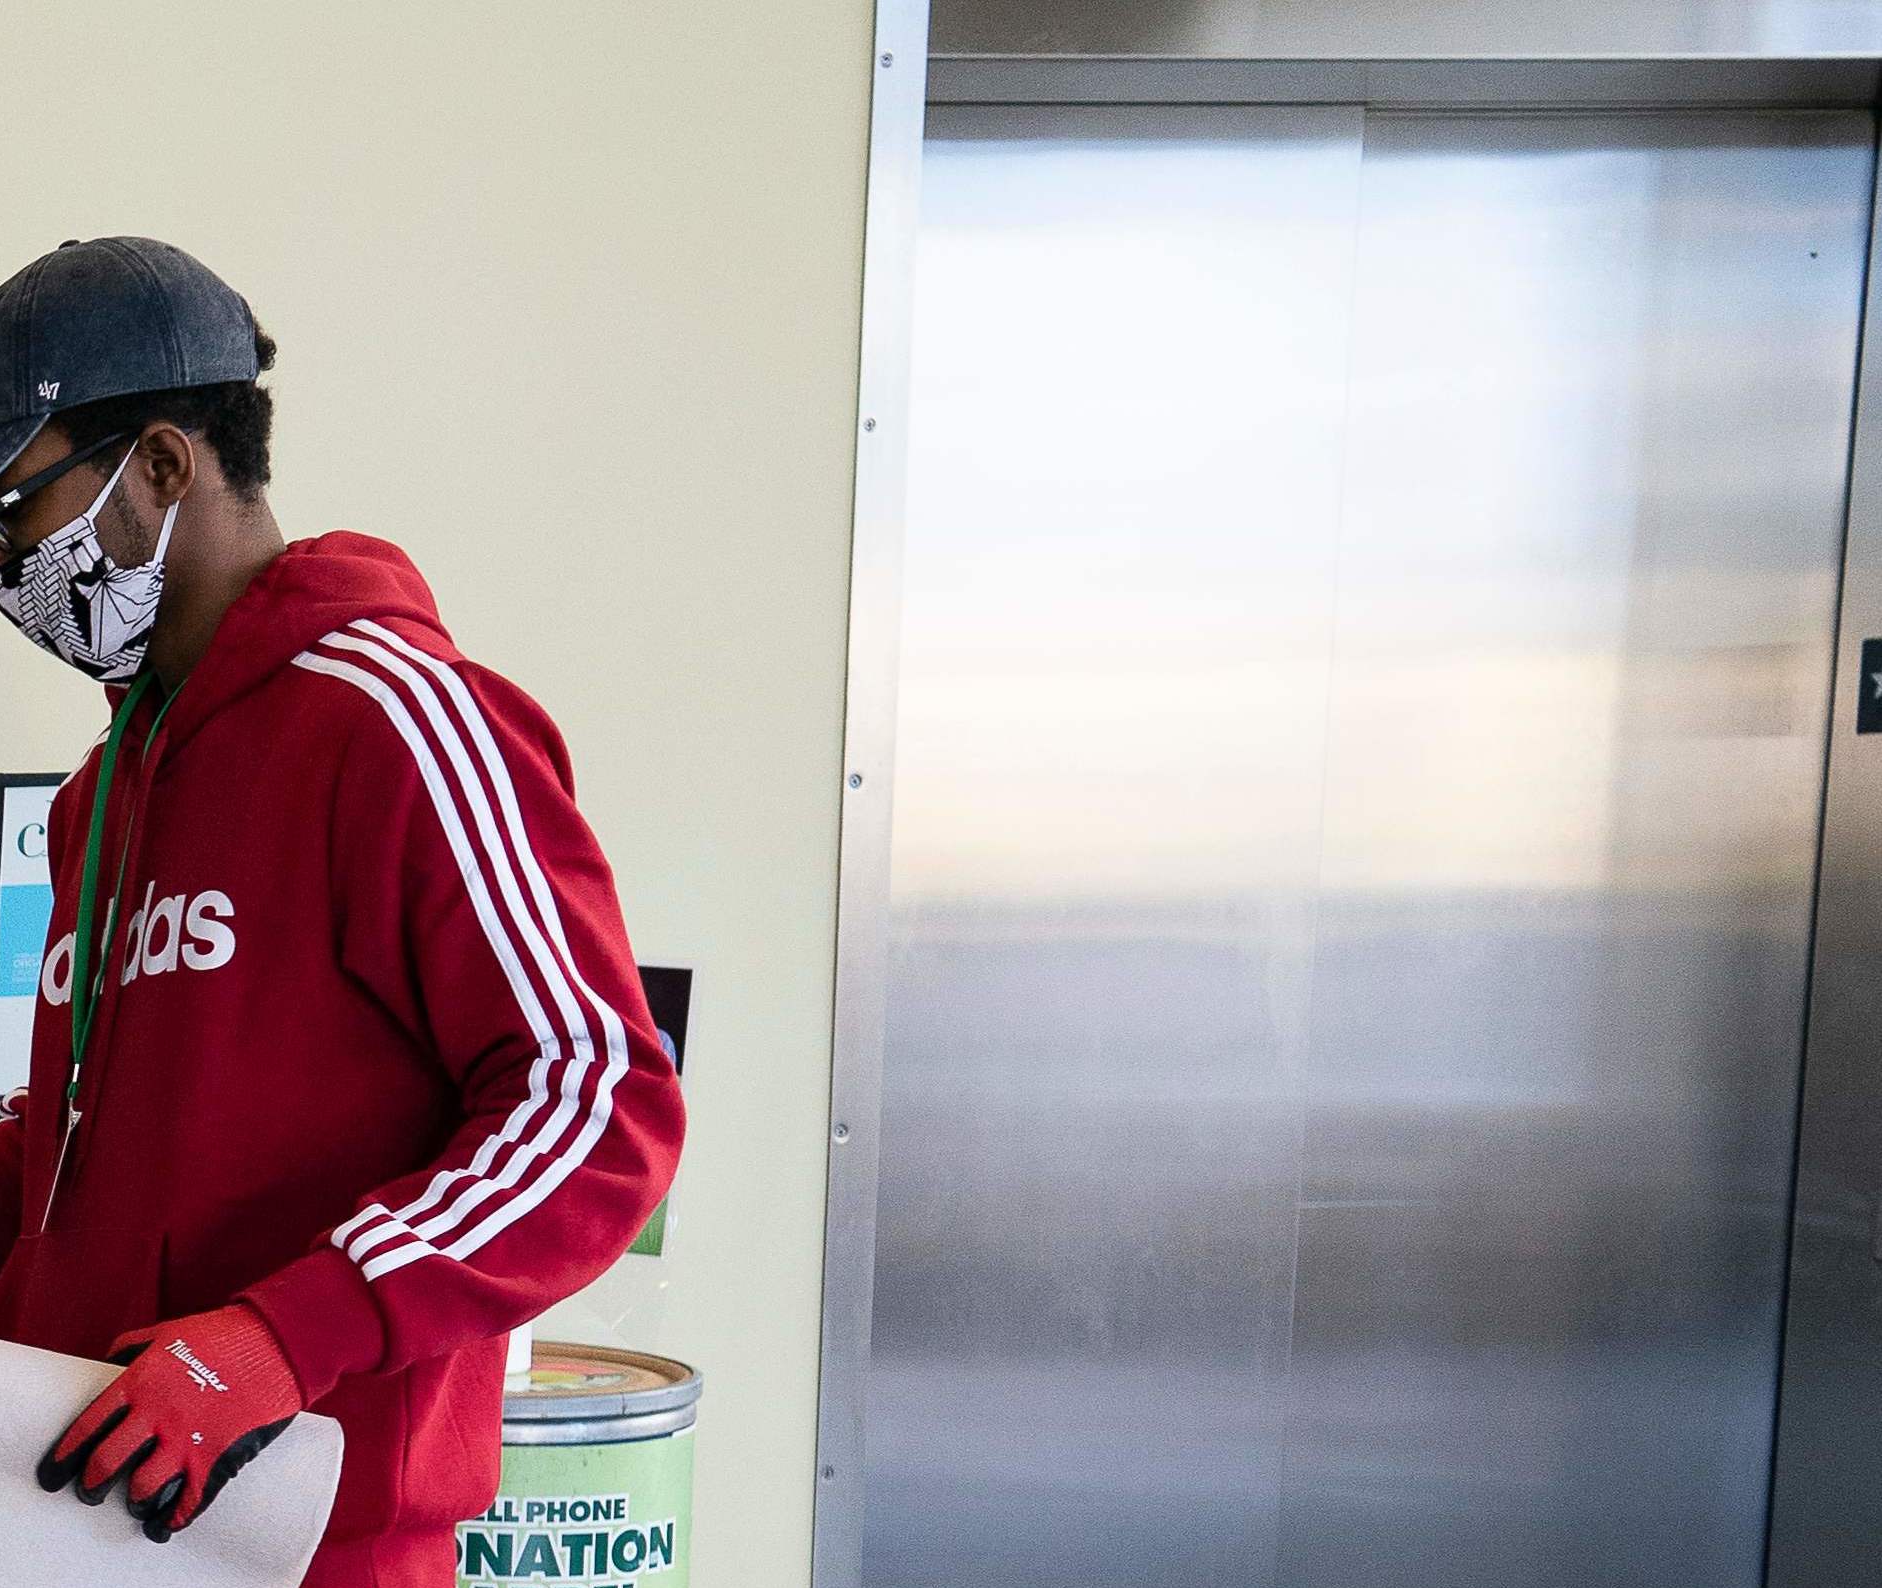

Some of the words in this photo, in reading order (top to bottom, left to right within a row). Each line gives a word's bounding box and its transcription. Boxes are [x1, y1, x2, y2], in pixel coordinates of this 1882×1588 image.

[475, 1501, 519, 1523] LL
[526, 1498, 626, 1523] PHONE
[456, 1522, 675, 1578] NATION
